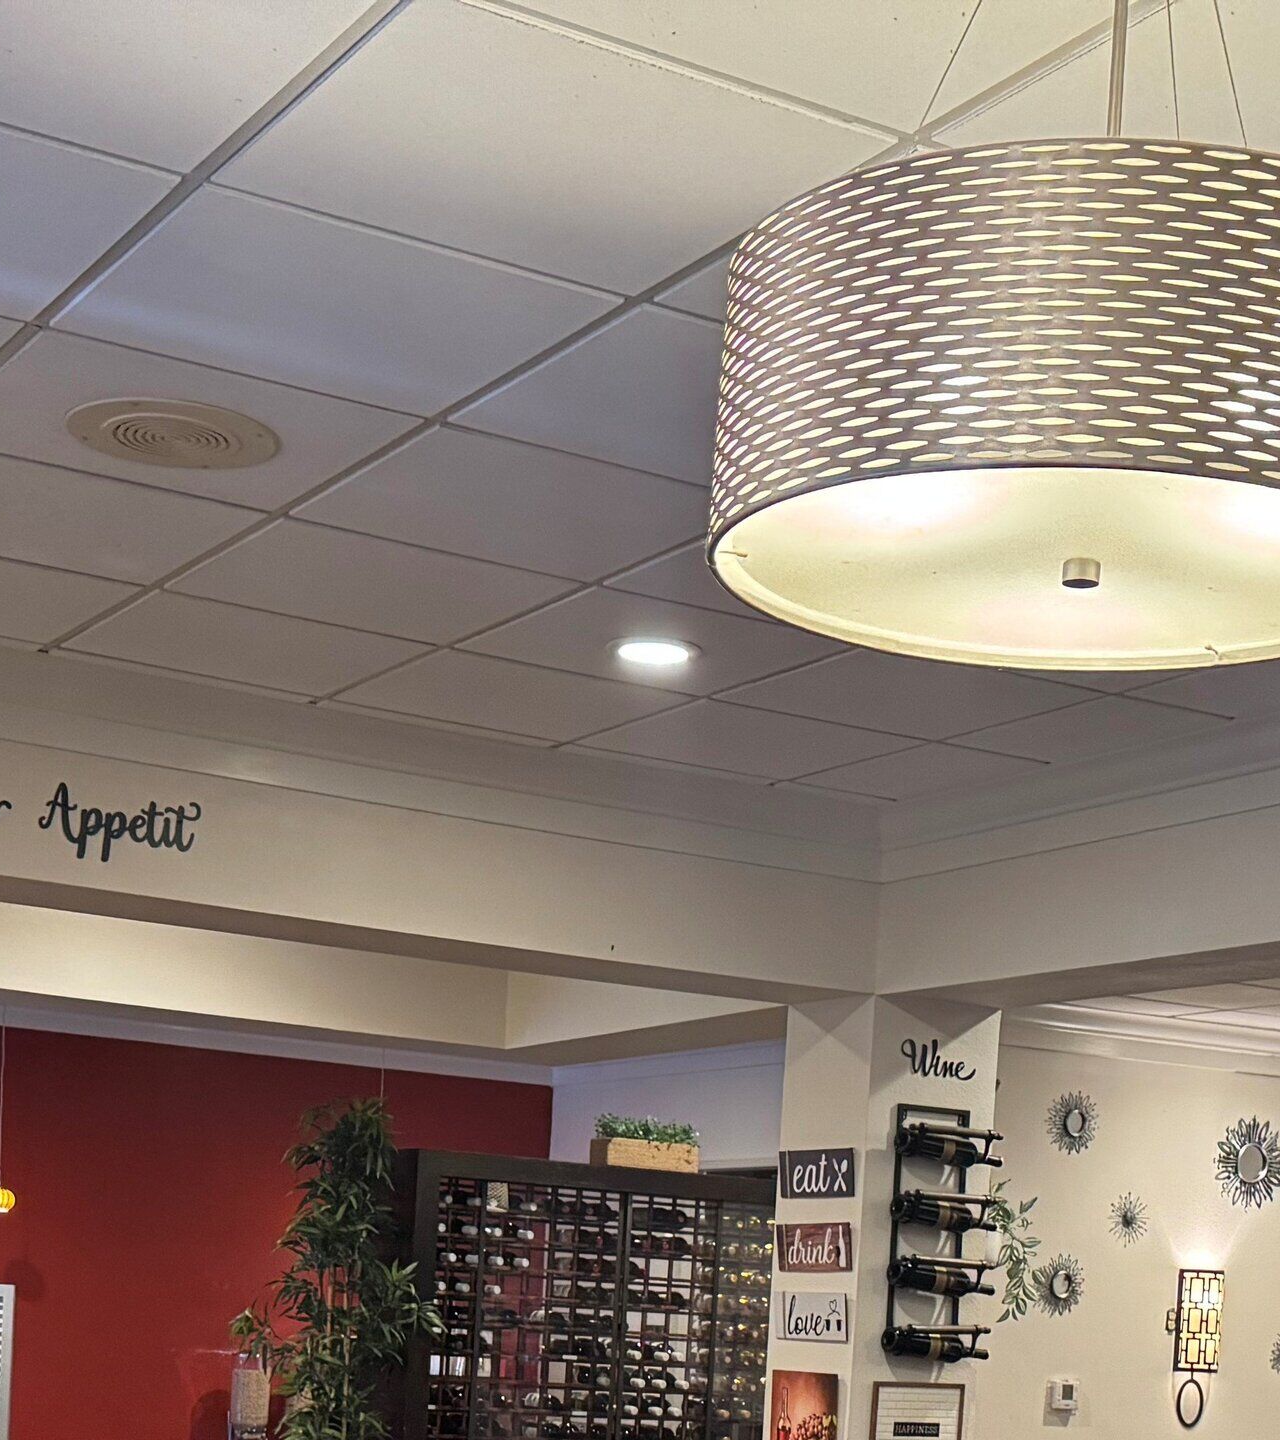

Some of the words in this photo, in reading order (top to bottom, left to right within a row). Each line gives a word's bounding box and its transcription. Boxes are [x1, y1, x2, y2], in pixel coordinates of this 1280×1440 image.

[38, 781, 201, 862] Appetit
[900, 1038, 977, 1081] Wine
[792, 1153, 831, 1193] eat
[788, 1228, 836, 1265] drink
[787, 1294, 826, 1336] love
[895, 1424, 939, 1434] HAPPINESS
